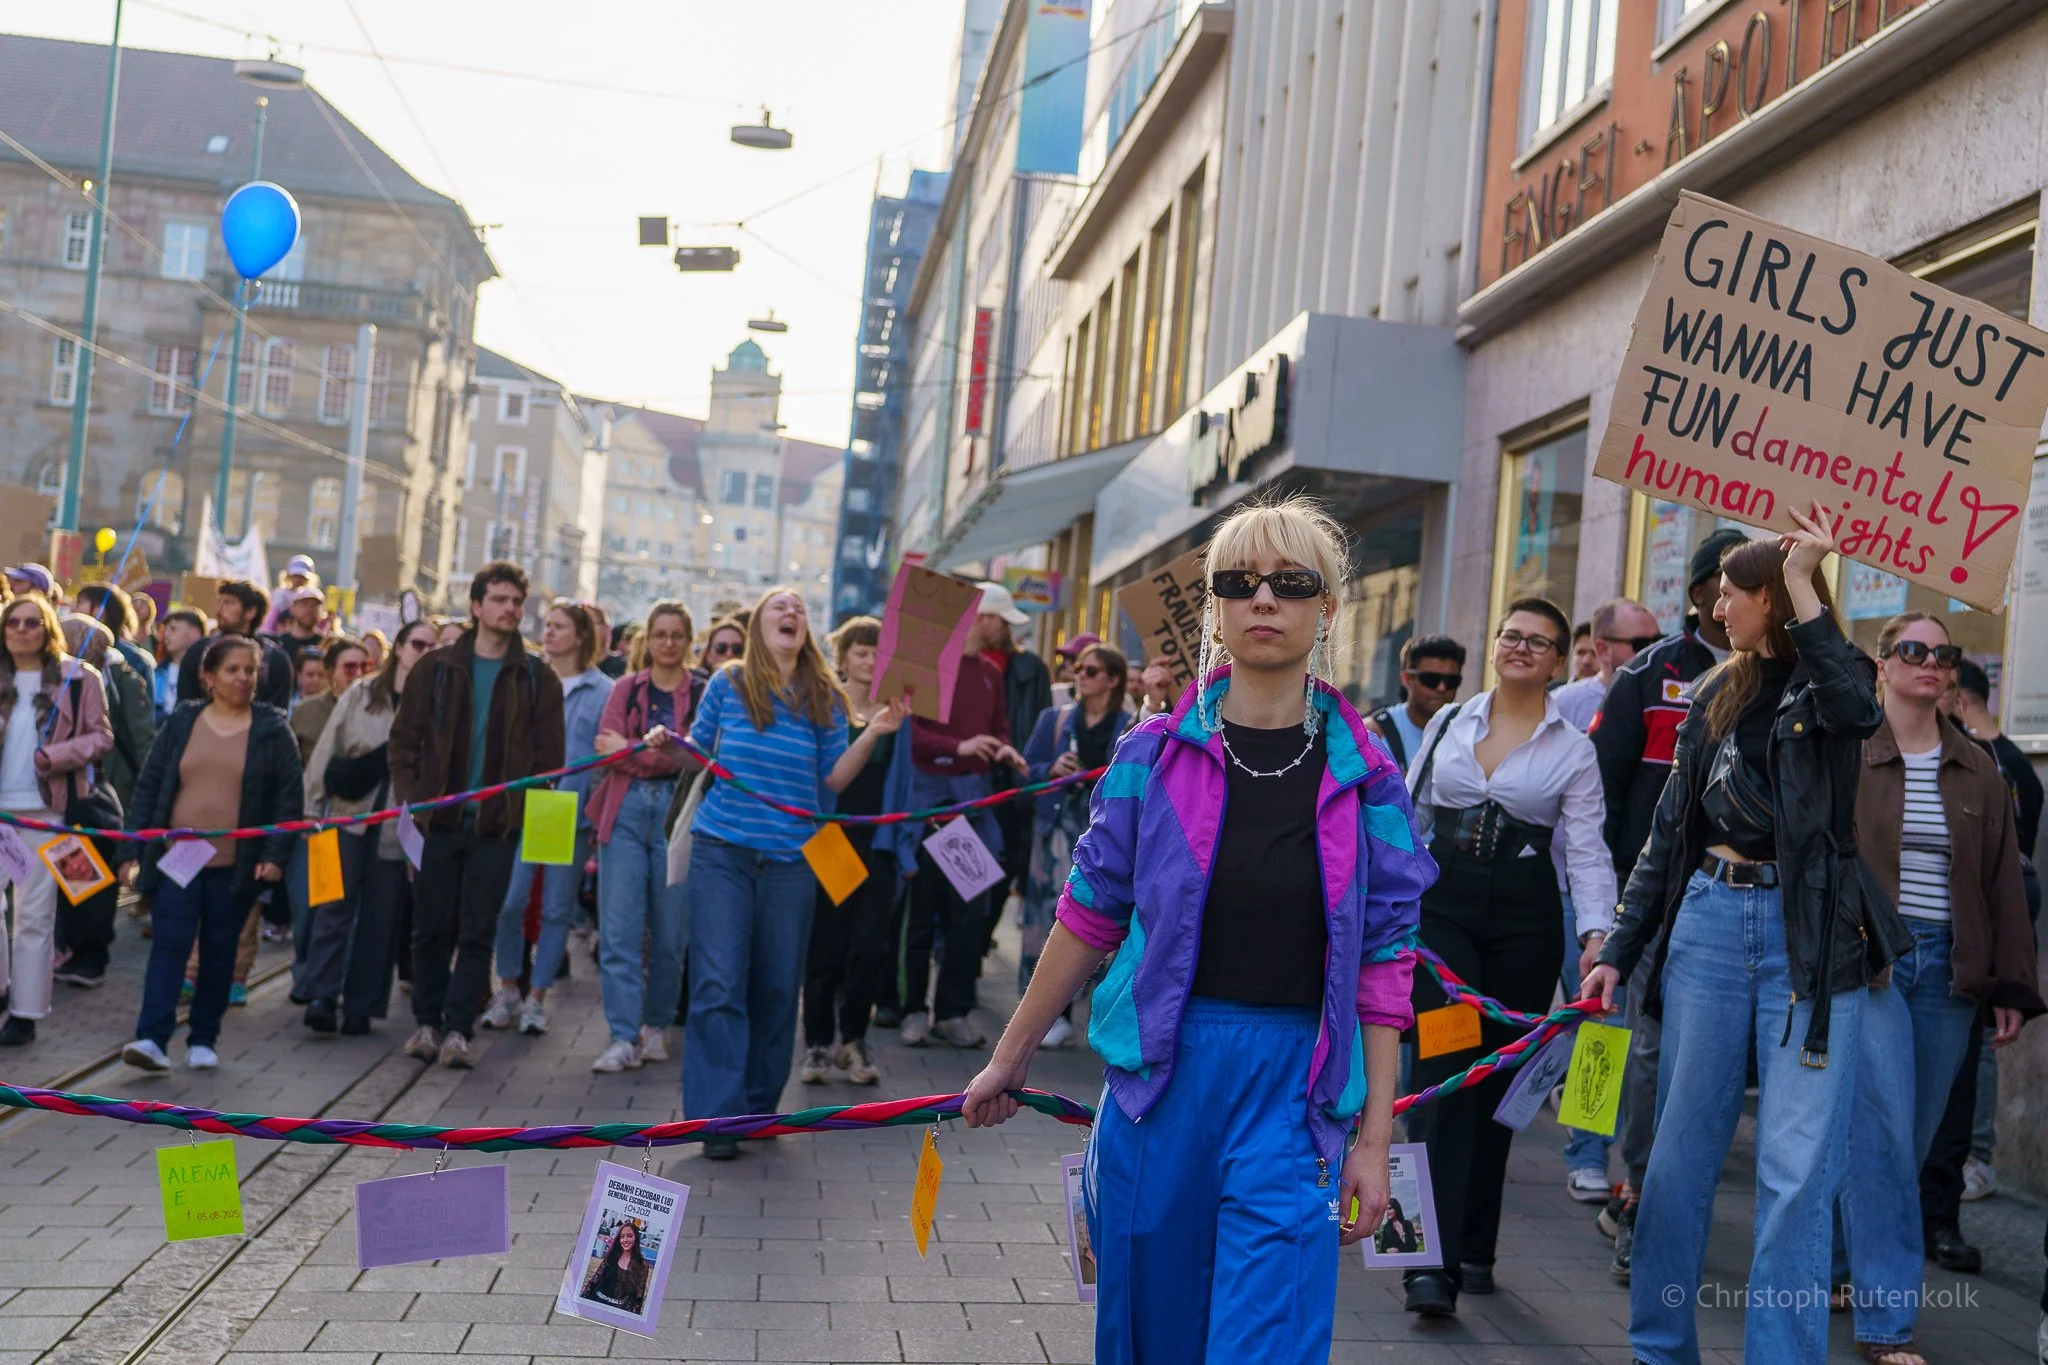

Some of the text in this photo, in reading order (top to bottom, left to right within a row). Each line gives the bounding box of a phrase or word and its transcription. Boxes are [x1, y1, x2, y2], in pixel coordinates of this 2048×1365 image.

[1683, 219, 2046, 402] GIRLS JUST
[1662, 296, 1987, 466] WANNA HAVE
[1623, 433, 1775, 521] human
[167, 1163, 231, 1186] ALENA
[607, 1190, 629, 1202] GENERAL
[608, 1180, 635, 1195] DEBANHI
